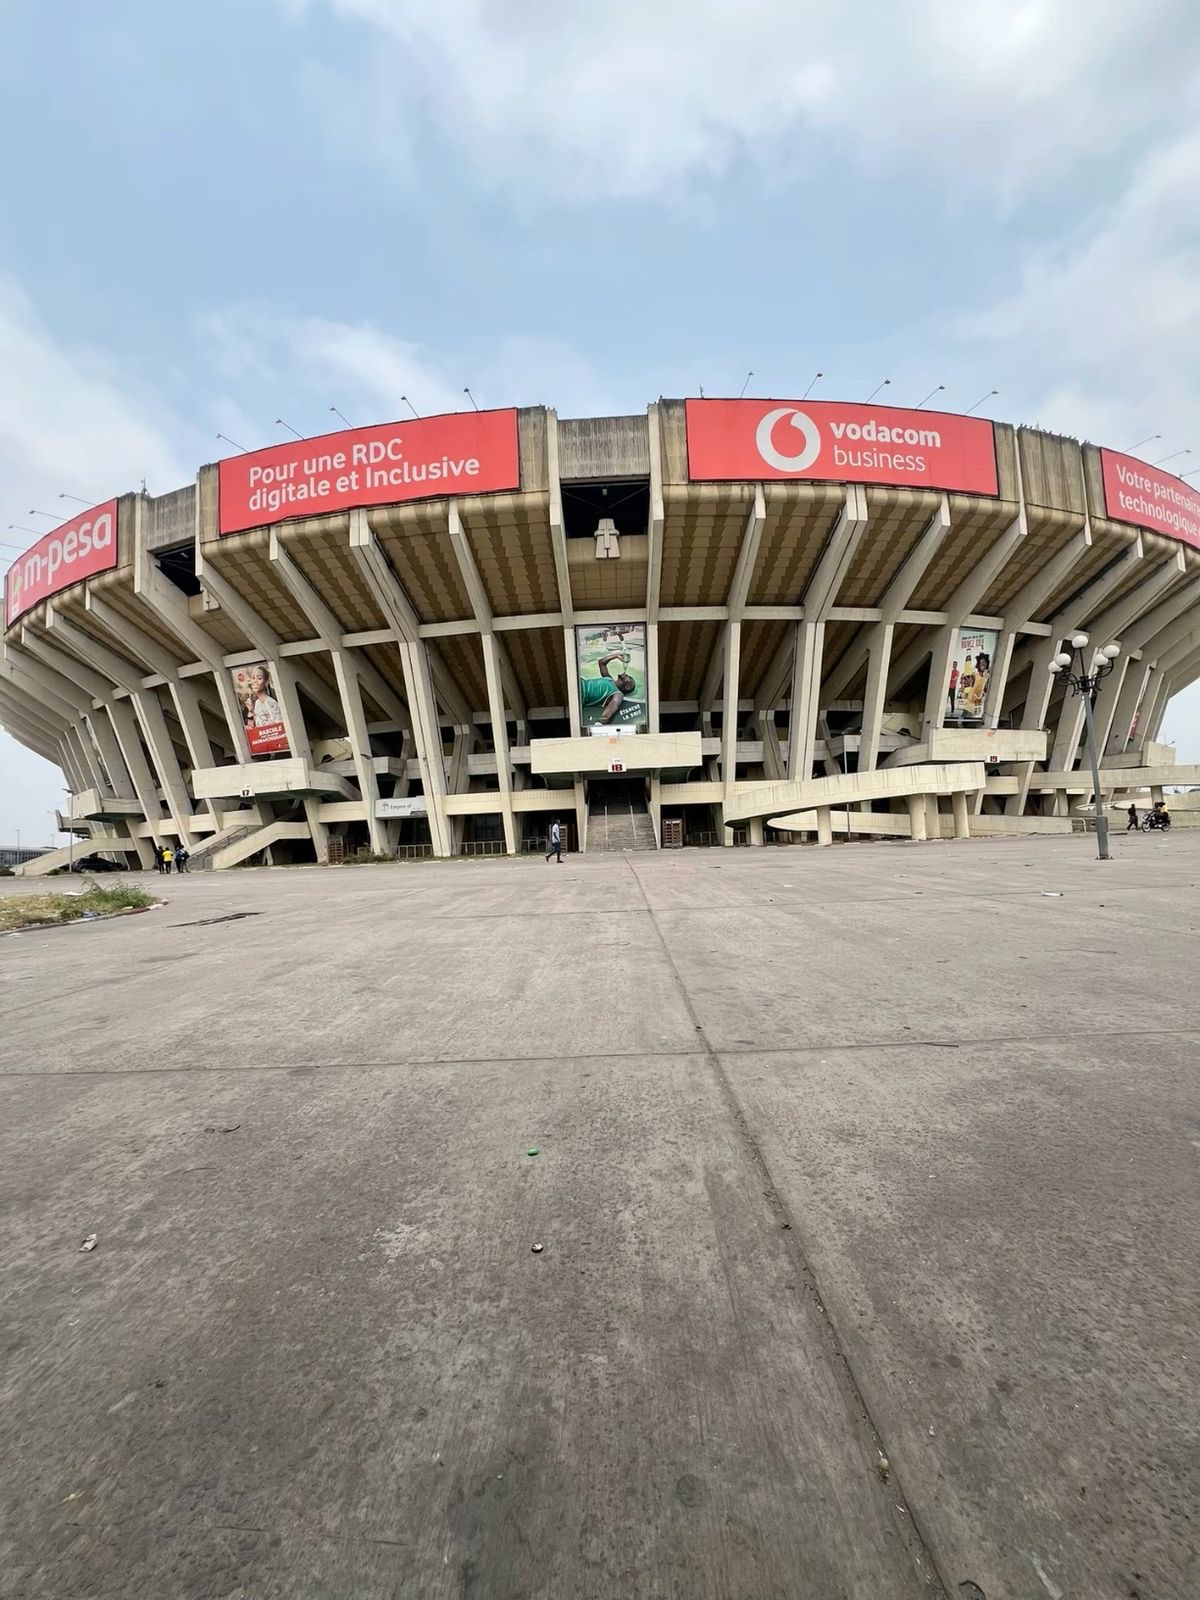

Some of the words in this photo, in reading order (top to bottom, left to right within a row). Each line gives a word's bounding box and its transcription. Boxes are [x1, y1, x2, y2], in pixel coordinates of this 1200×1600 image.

[829, 419, 942, 448] vodacom
[249, 461, 299, 488] Pour
[303, 452, 346, 475] une
[352, 438, 403, 466] RDC
[834, 445, 925, 472] business
[1116, 464, 1151, 492] Votre
[249, 477, 331, 511] digitale
[336, 471, 360, 492] et
[366, 456, 480, 488] Inclusive
[1119, 490, 1198, 537] technologique
[24, 513, 112, 592] m-pesa
